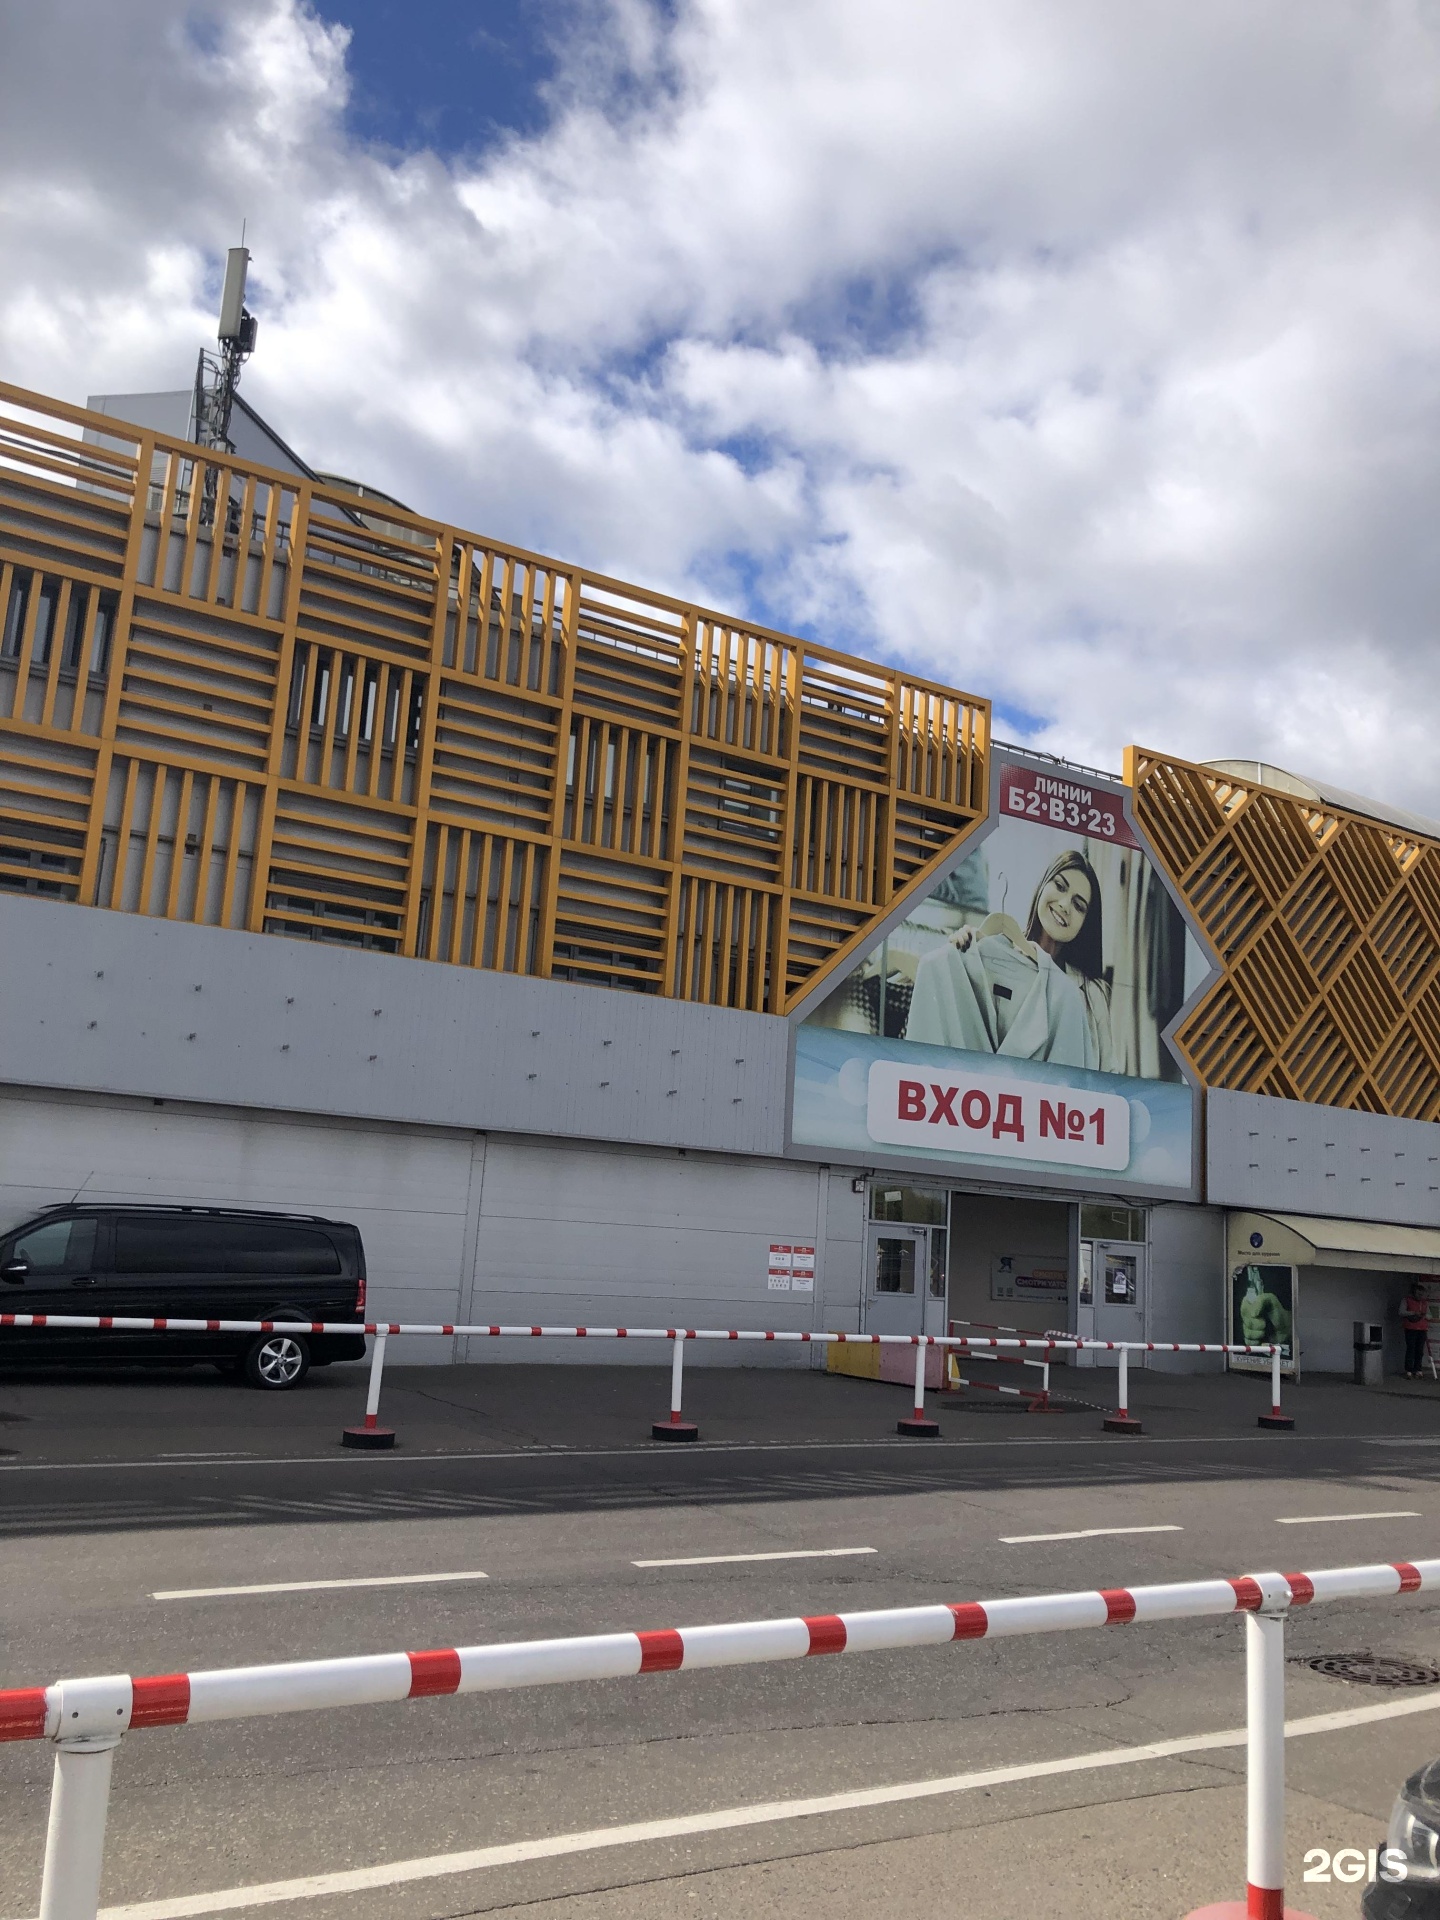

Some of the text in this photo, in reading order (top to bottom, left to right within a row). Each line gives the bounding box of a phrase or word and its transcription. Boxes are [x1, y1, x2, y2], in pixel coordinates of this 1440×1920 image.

[1035, 776, 1092, 806] ЛИНИИ
[898, 1079, 1105, 1146] ВХОД №1
